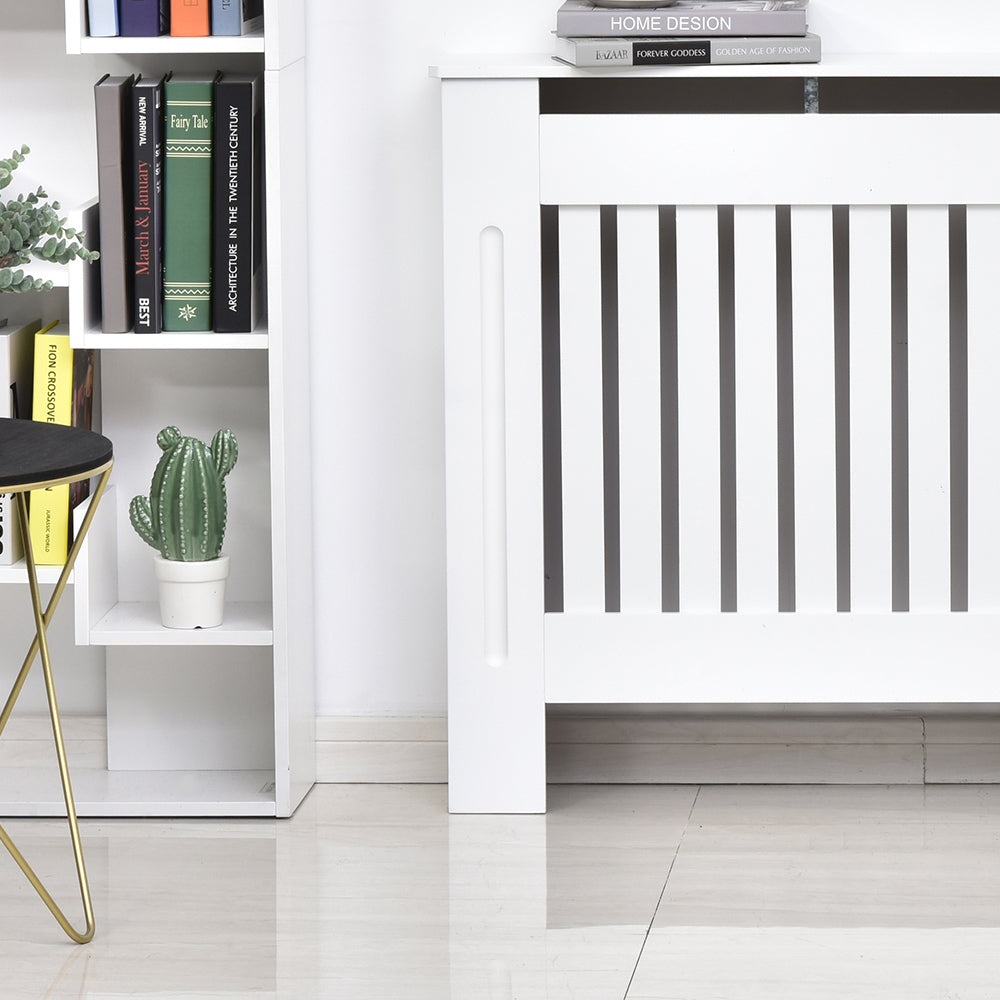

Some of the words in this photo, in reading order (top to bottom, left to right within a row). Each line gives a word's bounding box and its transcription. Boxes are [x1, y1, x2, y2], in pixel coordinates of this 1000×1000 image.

[610, 16, 661, 30] HOME
[667, 16, 732, 31] DESION
[595, 49, 629, 60] BAZAAR
[636, 49, 669, 58] FOREVER
[670, 48, 706, 57] GODDESS
[715, 47, 748, 56] GOLDEN
[749, 47, 764, 56] AGE
[765, 46, 776, 55] OF
[778, 46, 811, 55] FASHION
[138, 96, 147, 113] NEW
[138, 113, 147, 146] ARRIVAL
[170, 114, 190, 132] Fairy
[191, 114, 209, 129] Tale
[229, 105, 238, 149] CENTURY
[134, 160, 152, 214] January
[229, 150, 238, 203] TWENTIETH
[135, 216, 150, 228] &
[229, 206, 238, 224] THE
[229, 226, 238, 239] IN
[135, 229, 150, 275] March
[228, 243, 238, 312] ARCHITECTURE
[138, 298, 150, 327] BEST
[48, 344, 57, 368] FION
[47, 370, 57, 423] CROSSOVE
